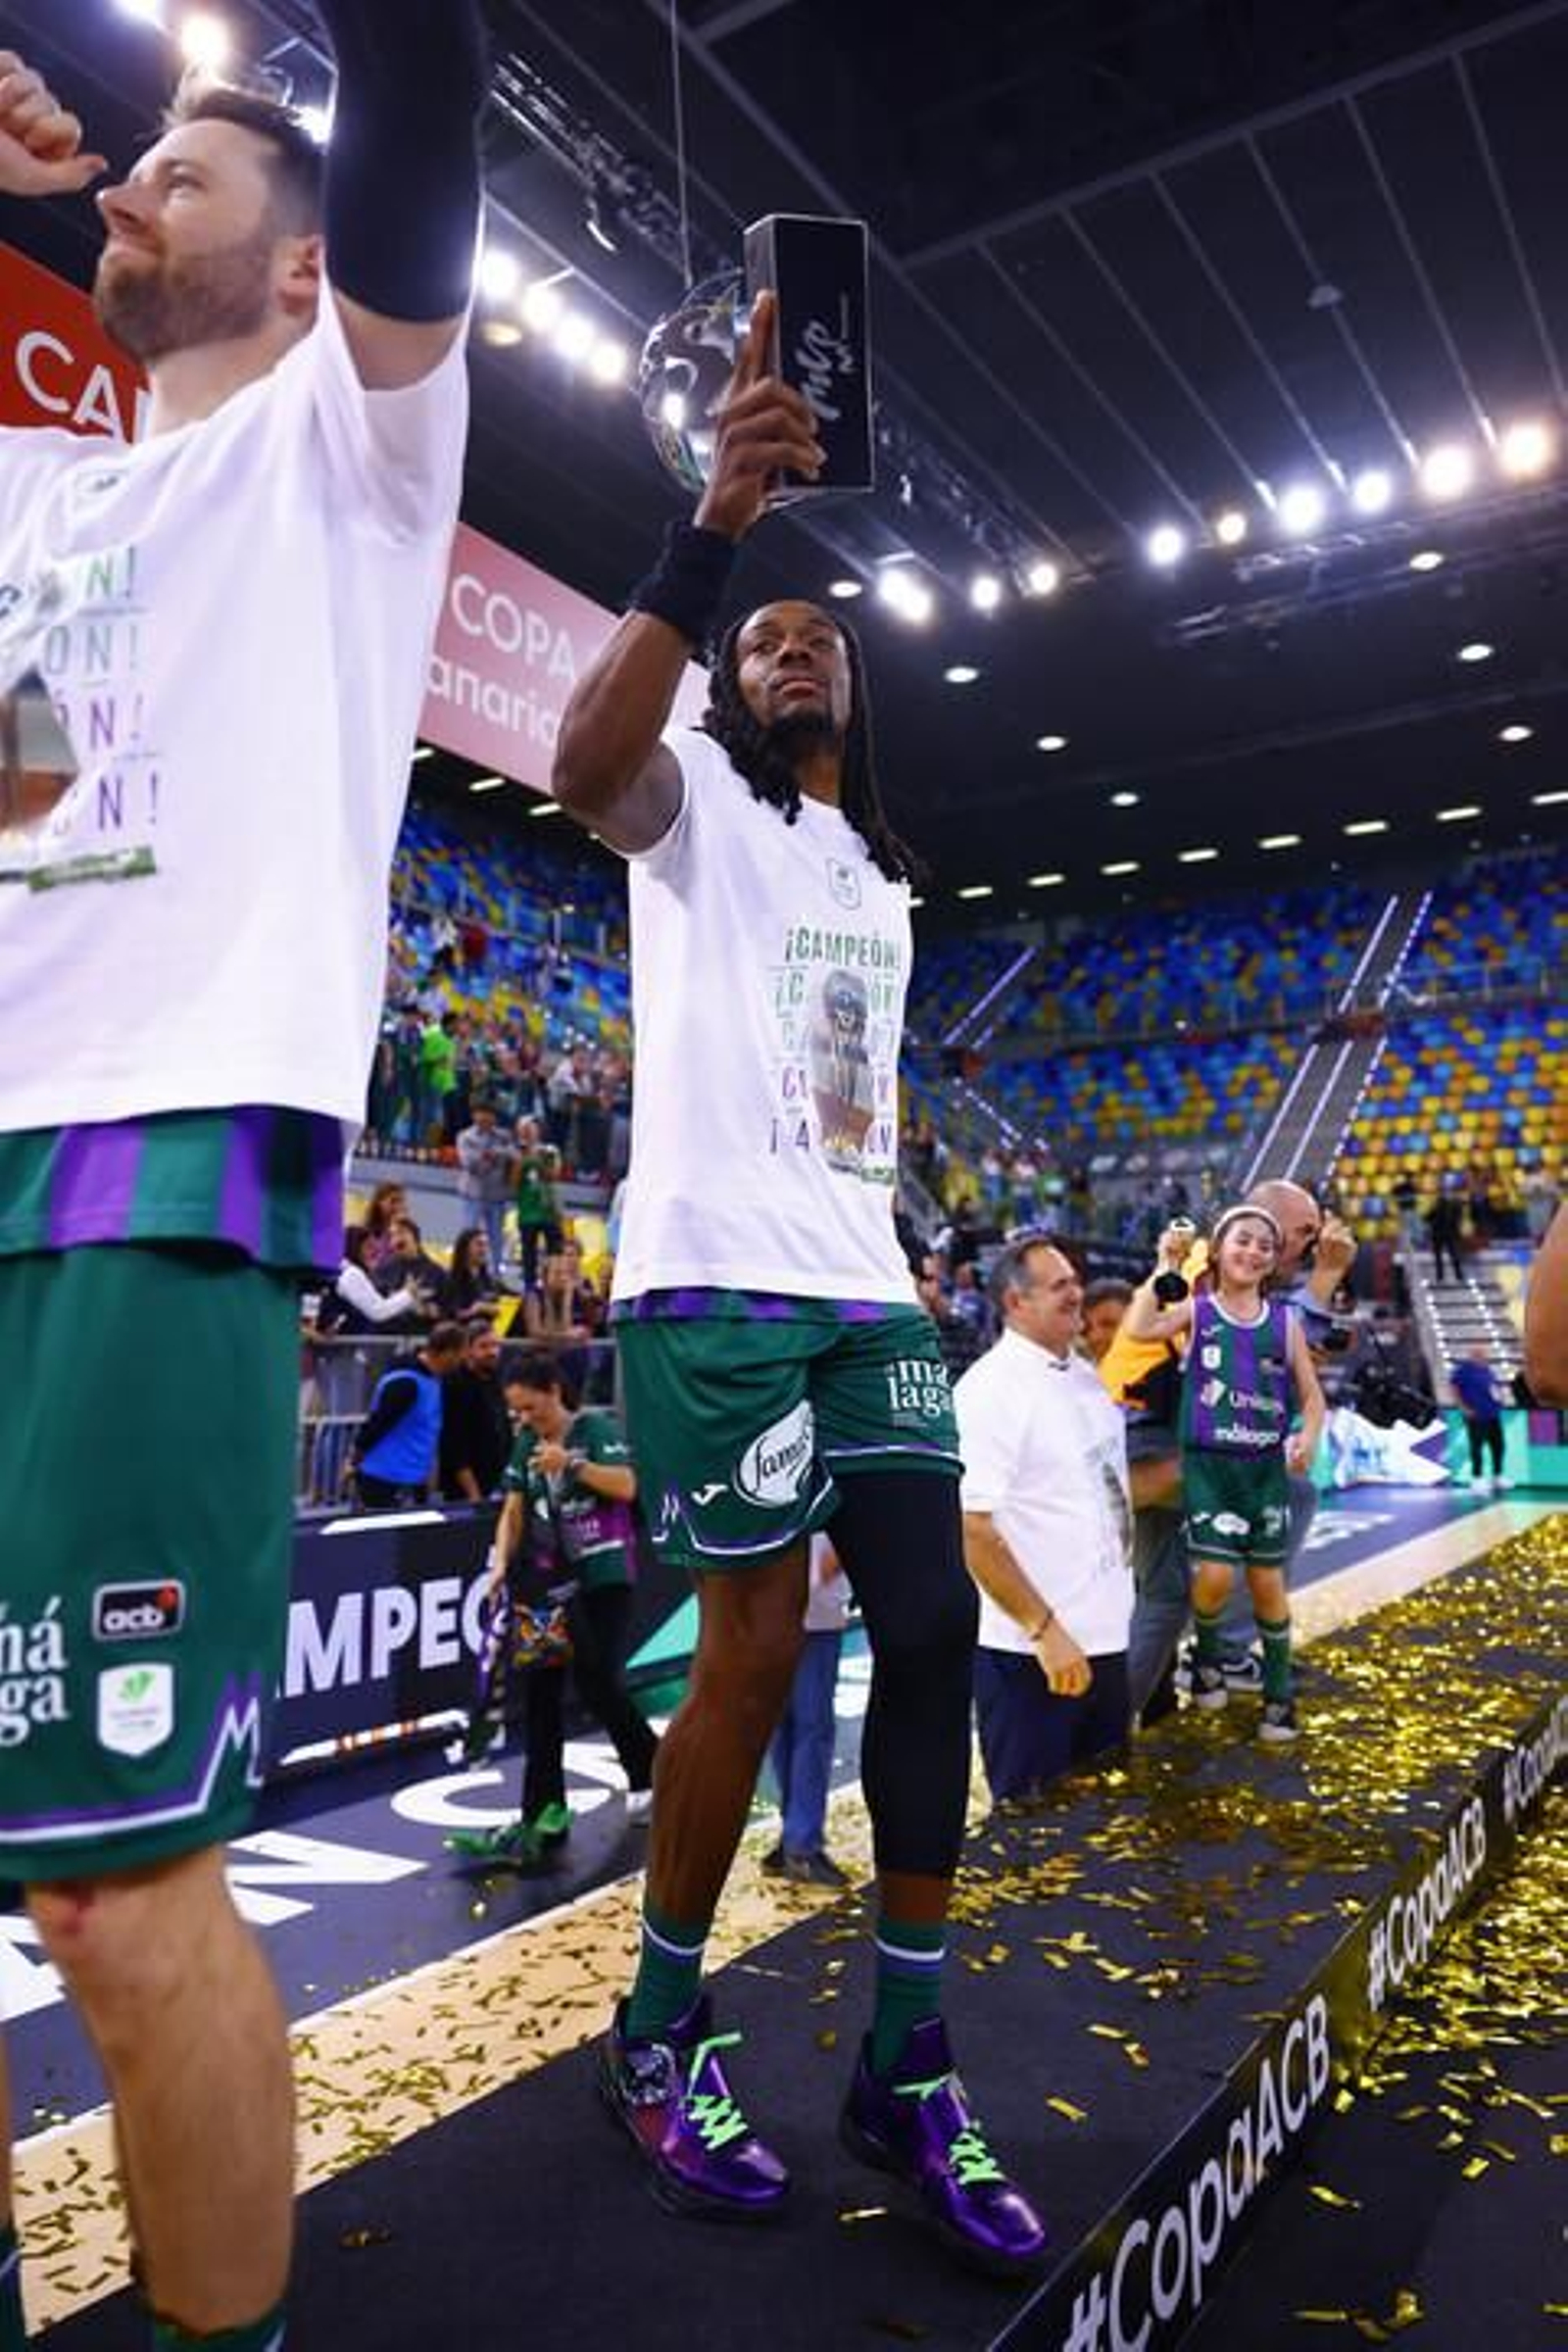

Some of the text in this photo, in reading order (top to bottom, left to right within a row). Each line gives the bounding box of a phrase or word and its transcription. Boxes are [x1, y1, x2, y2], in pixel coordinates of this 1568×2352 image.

[450, 573, 576, 680] COPA
[103, 1603, 165, 1632] acb
[1366, 1798, 1488, 2012] #CopaACB
[1062, 1994, 1331, 2352] #CopaACB
